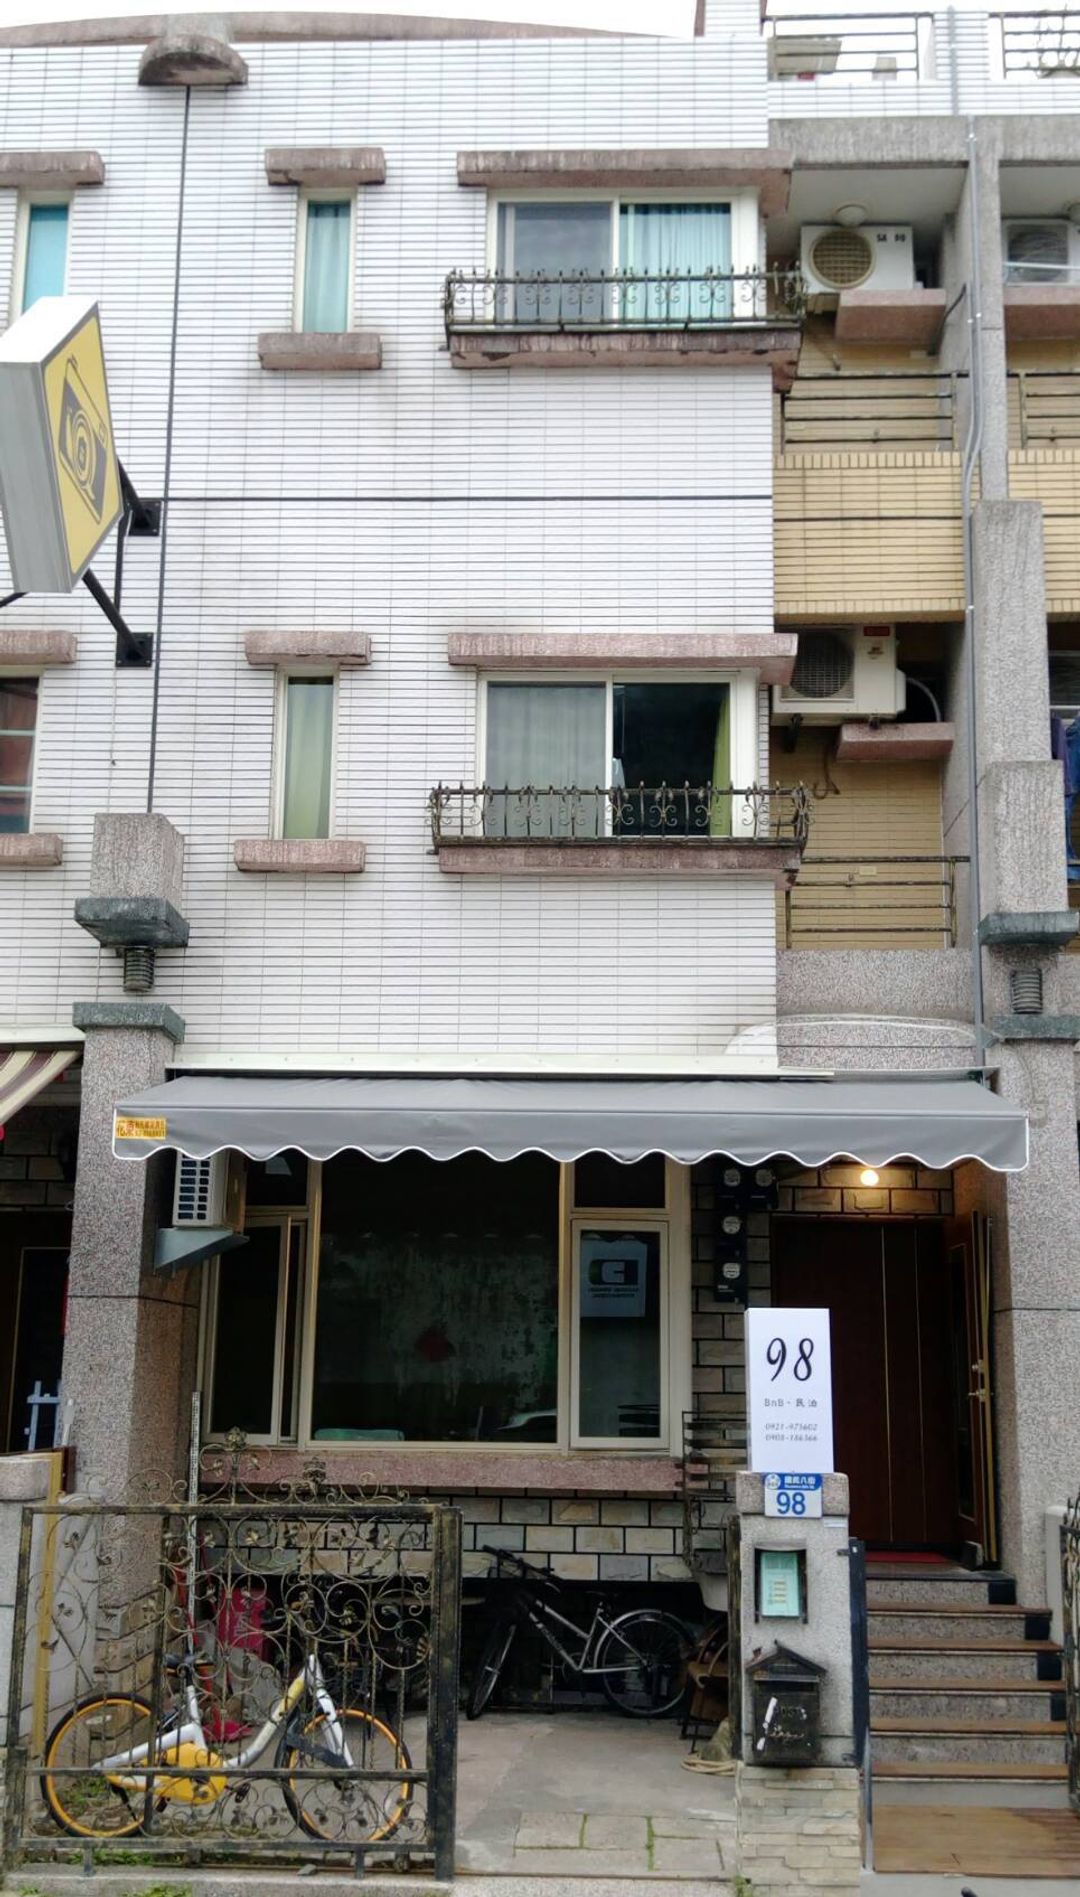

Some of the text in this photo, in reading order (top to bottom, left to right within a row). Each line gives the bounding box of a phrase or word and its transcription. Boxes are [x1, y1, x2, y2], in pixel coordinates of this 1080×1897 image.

[766, 1337, 814, 1382] 98
[764, 1398, 784, 1407] BnB
[776, 1491, 806, 1515] 98
